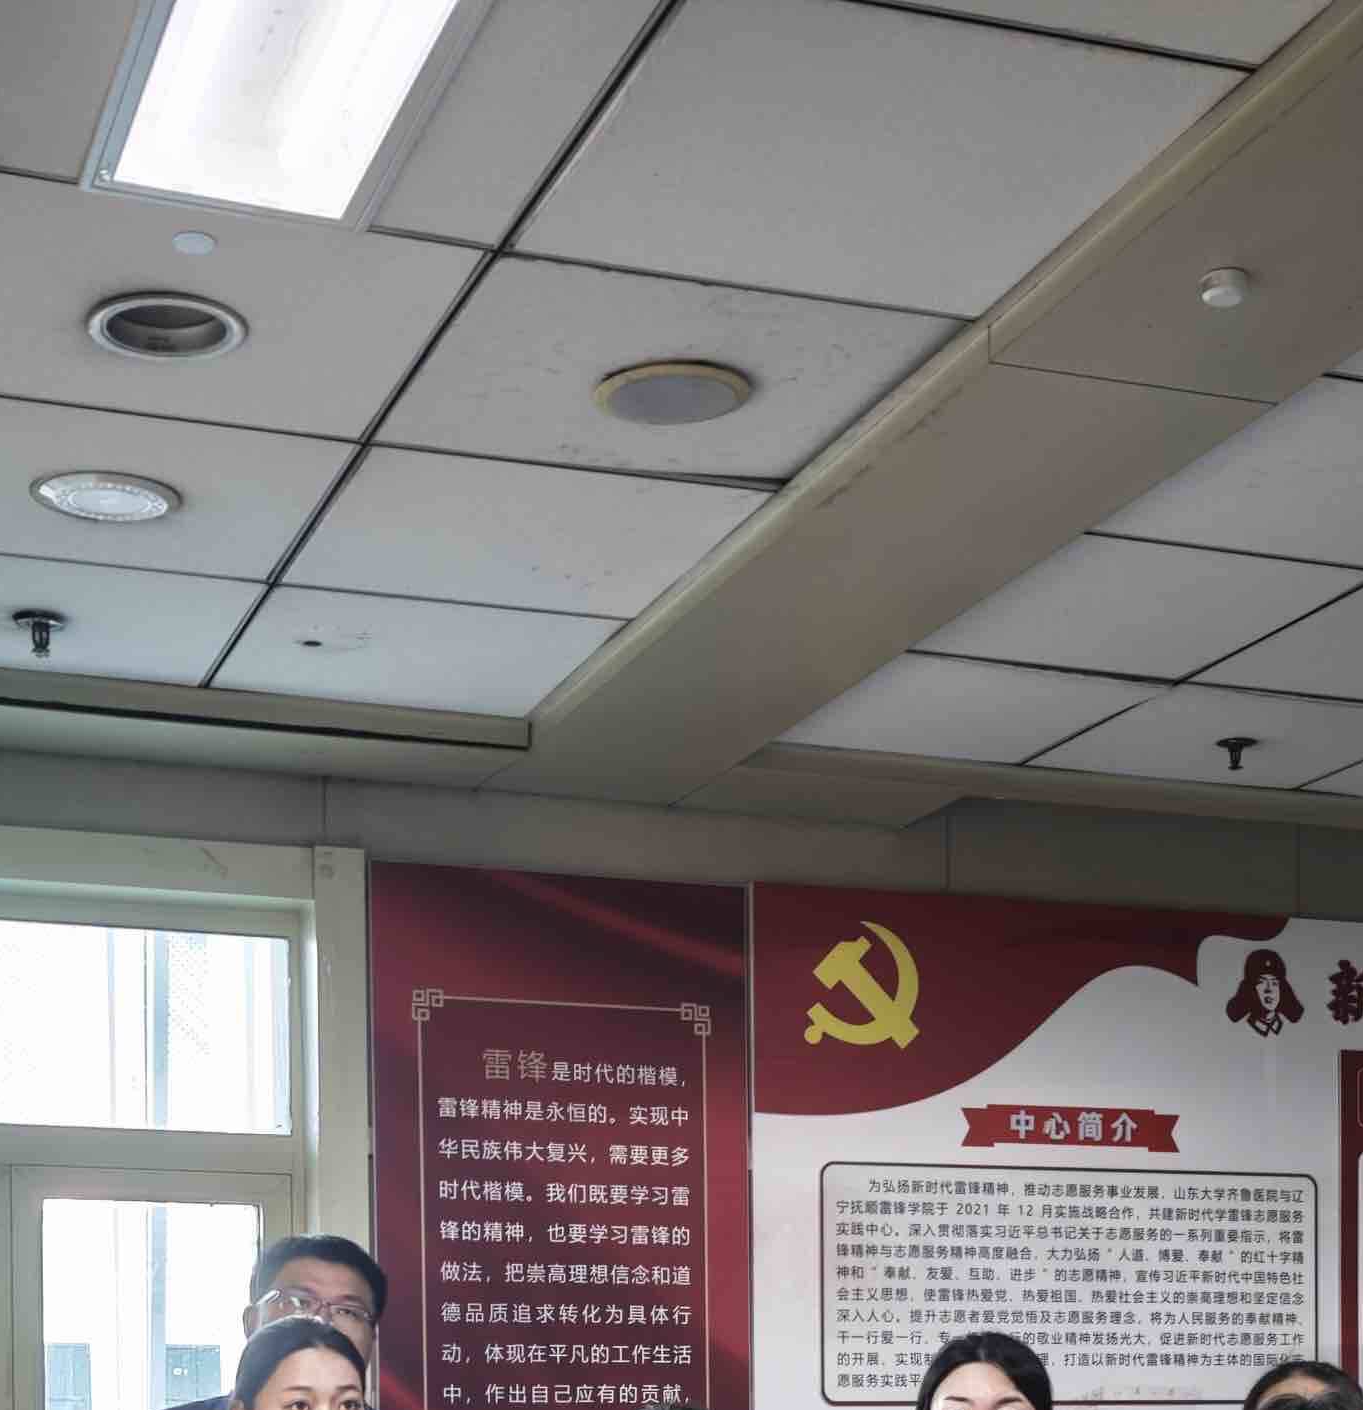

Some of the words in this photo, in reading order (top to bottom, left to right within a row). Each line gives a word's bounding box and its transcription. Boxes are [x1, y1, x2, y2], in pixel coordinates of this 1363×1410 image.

[1009, 1110, 1138, 1142] 中心简介
[440, 1301, 692, 1327] 德品质追求转化为具体行
[837, 1373, 926, 1388] 愿服务实践平
